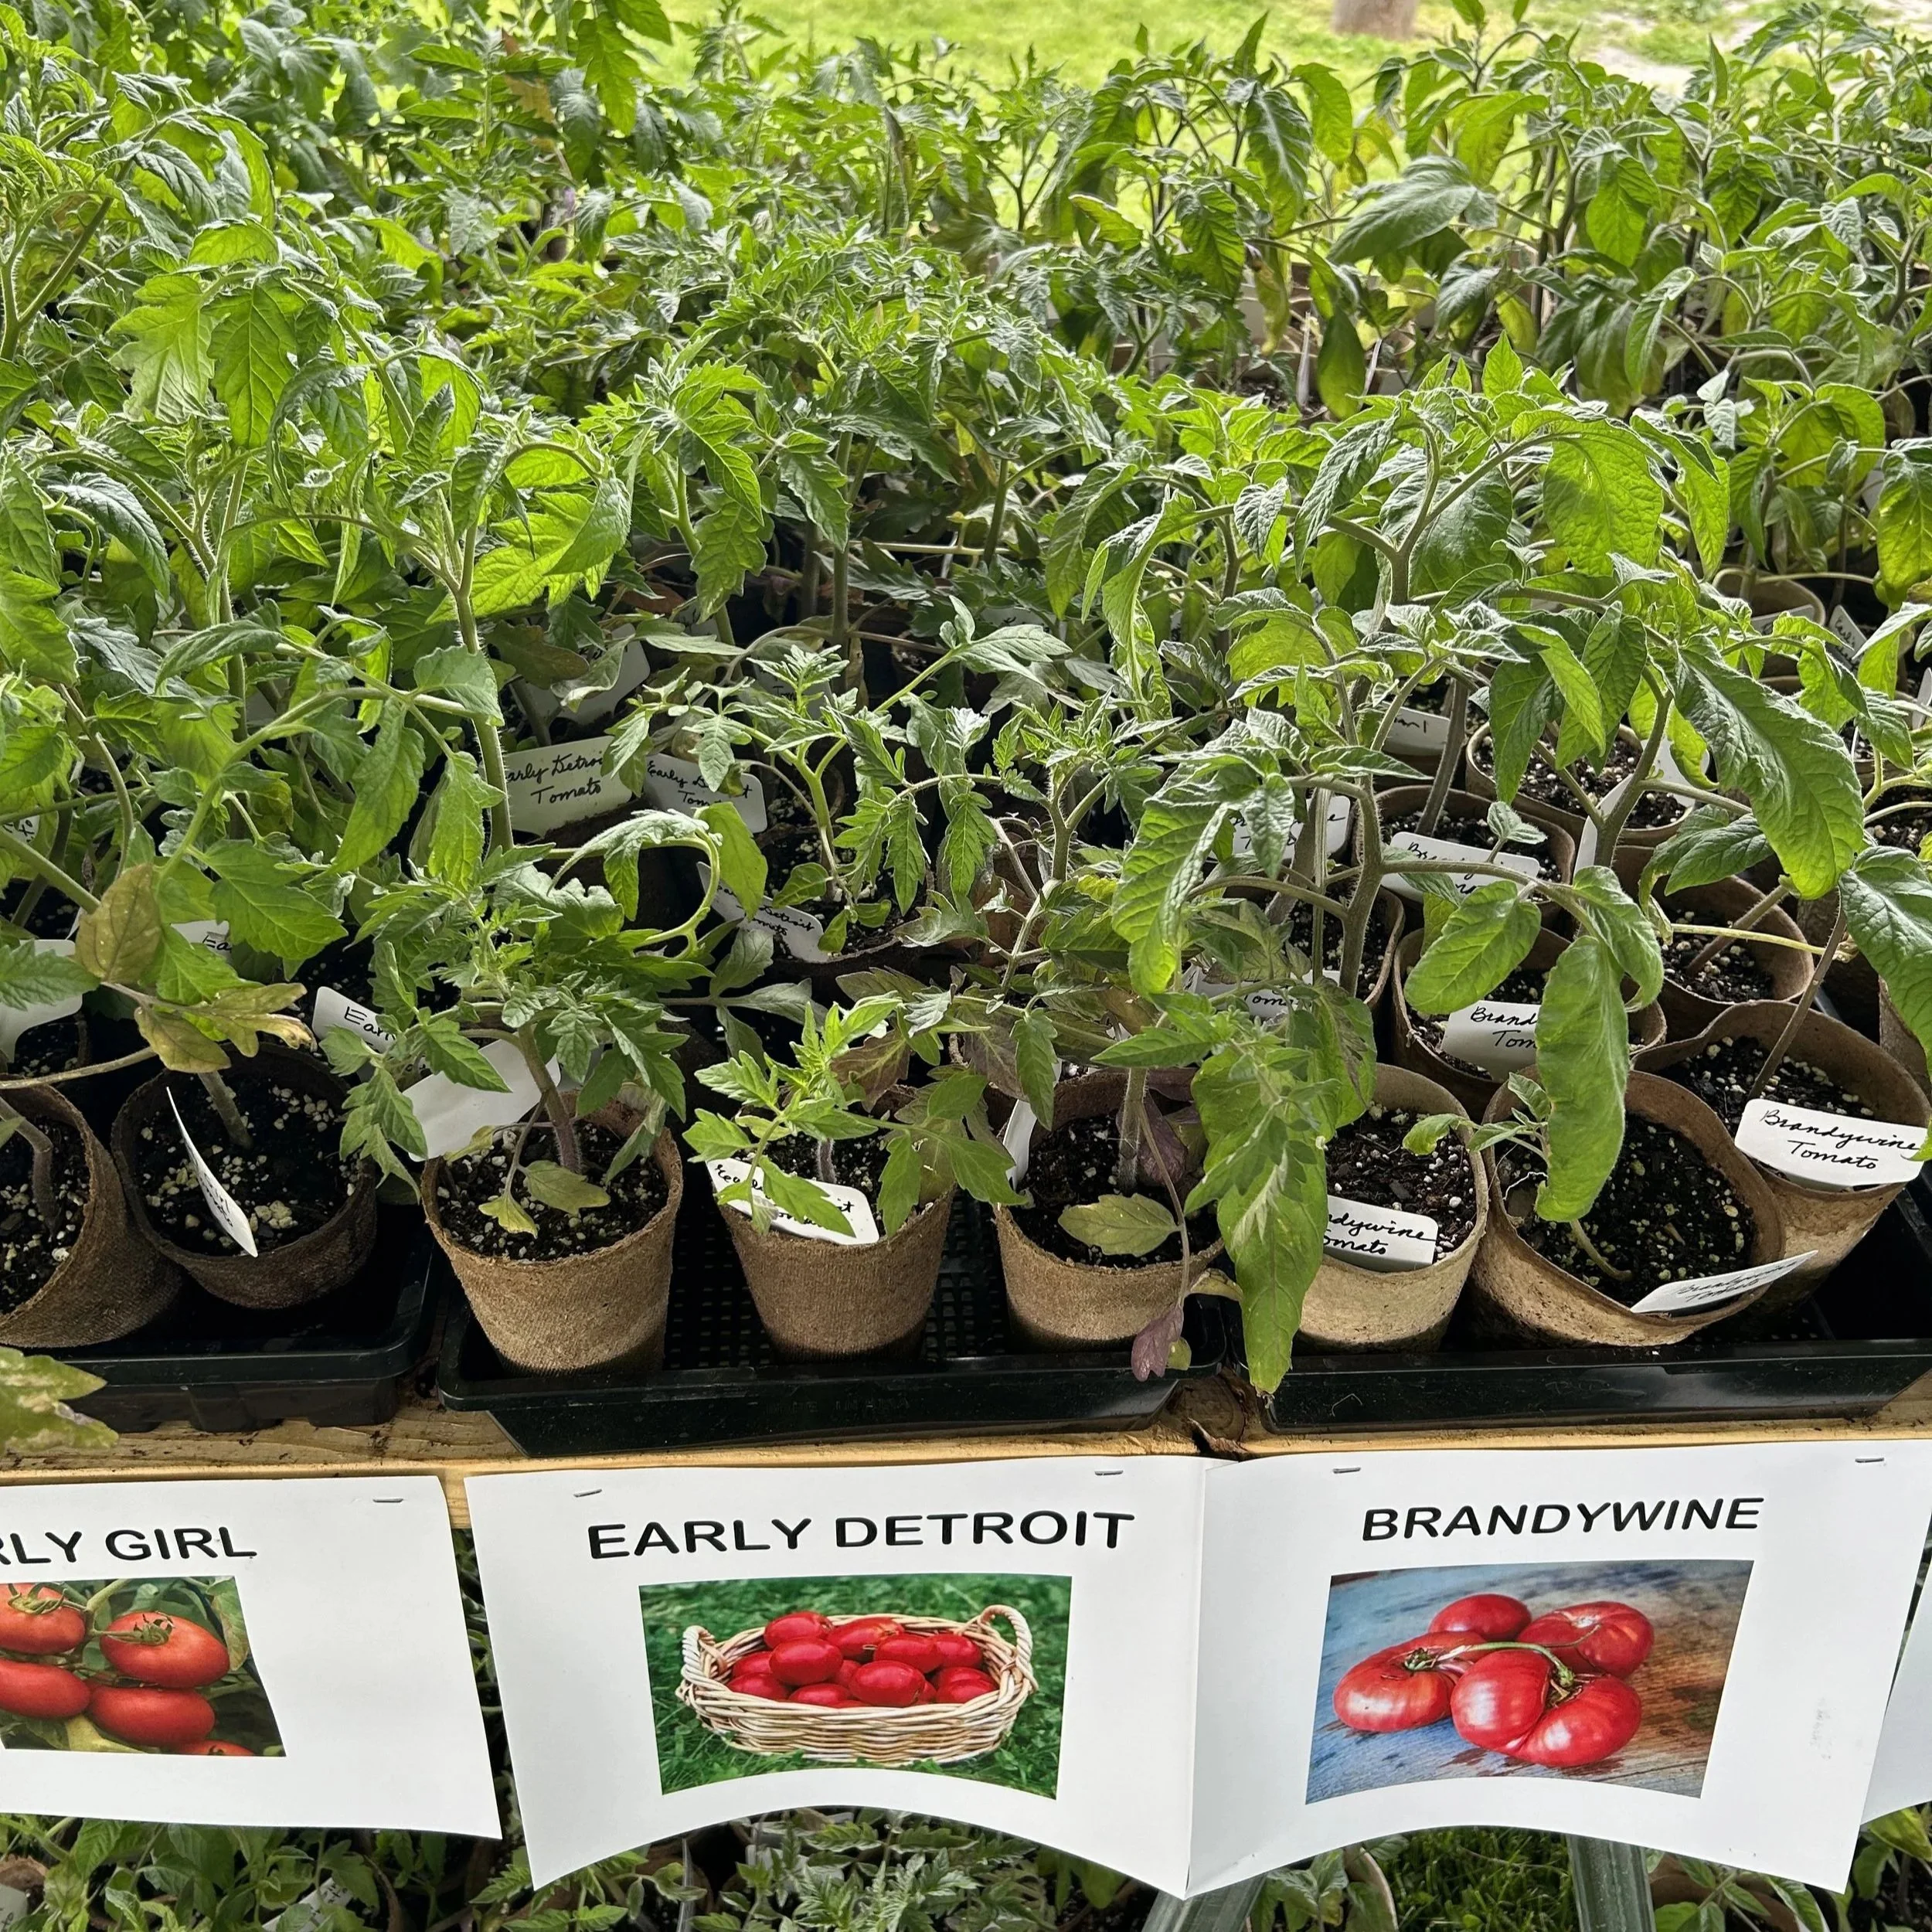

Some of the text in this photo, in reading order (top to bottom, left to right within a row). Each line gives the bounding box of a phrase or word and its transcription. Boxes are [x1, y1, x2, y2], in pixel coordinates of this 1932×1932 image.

[505, 750, 603, 784] arly Detroi
[647, 760, 689, 787] Early
[530, 777, 603, 804] Tomato
[1470, 1005, 1538, 1026] Brand
[1492, 1029, 1538, 1049] Tom
[1760, 1109, 1921, 1151] Brandywine
[1787, 1139, 1879, 1170] Tomato
[1328, 1212, 1437, 1237] dywine
[1323, 1229, 1389, 1256] omato
[1362, 1498, 1764, 1541] BRANDYWINE
[0, 1526, 257, 1565] LY GIRL
[587, 1510, 1135, 1560] EARLY DETROIT
